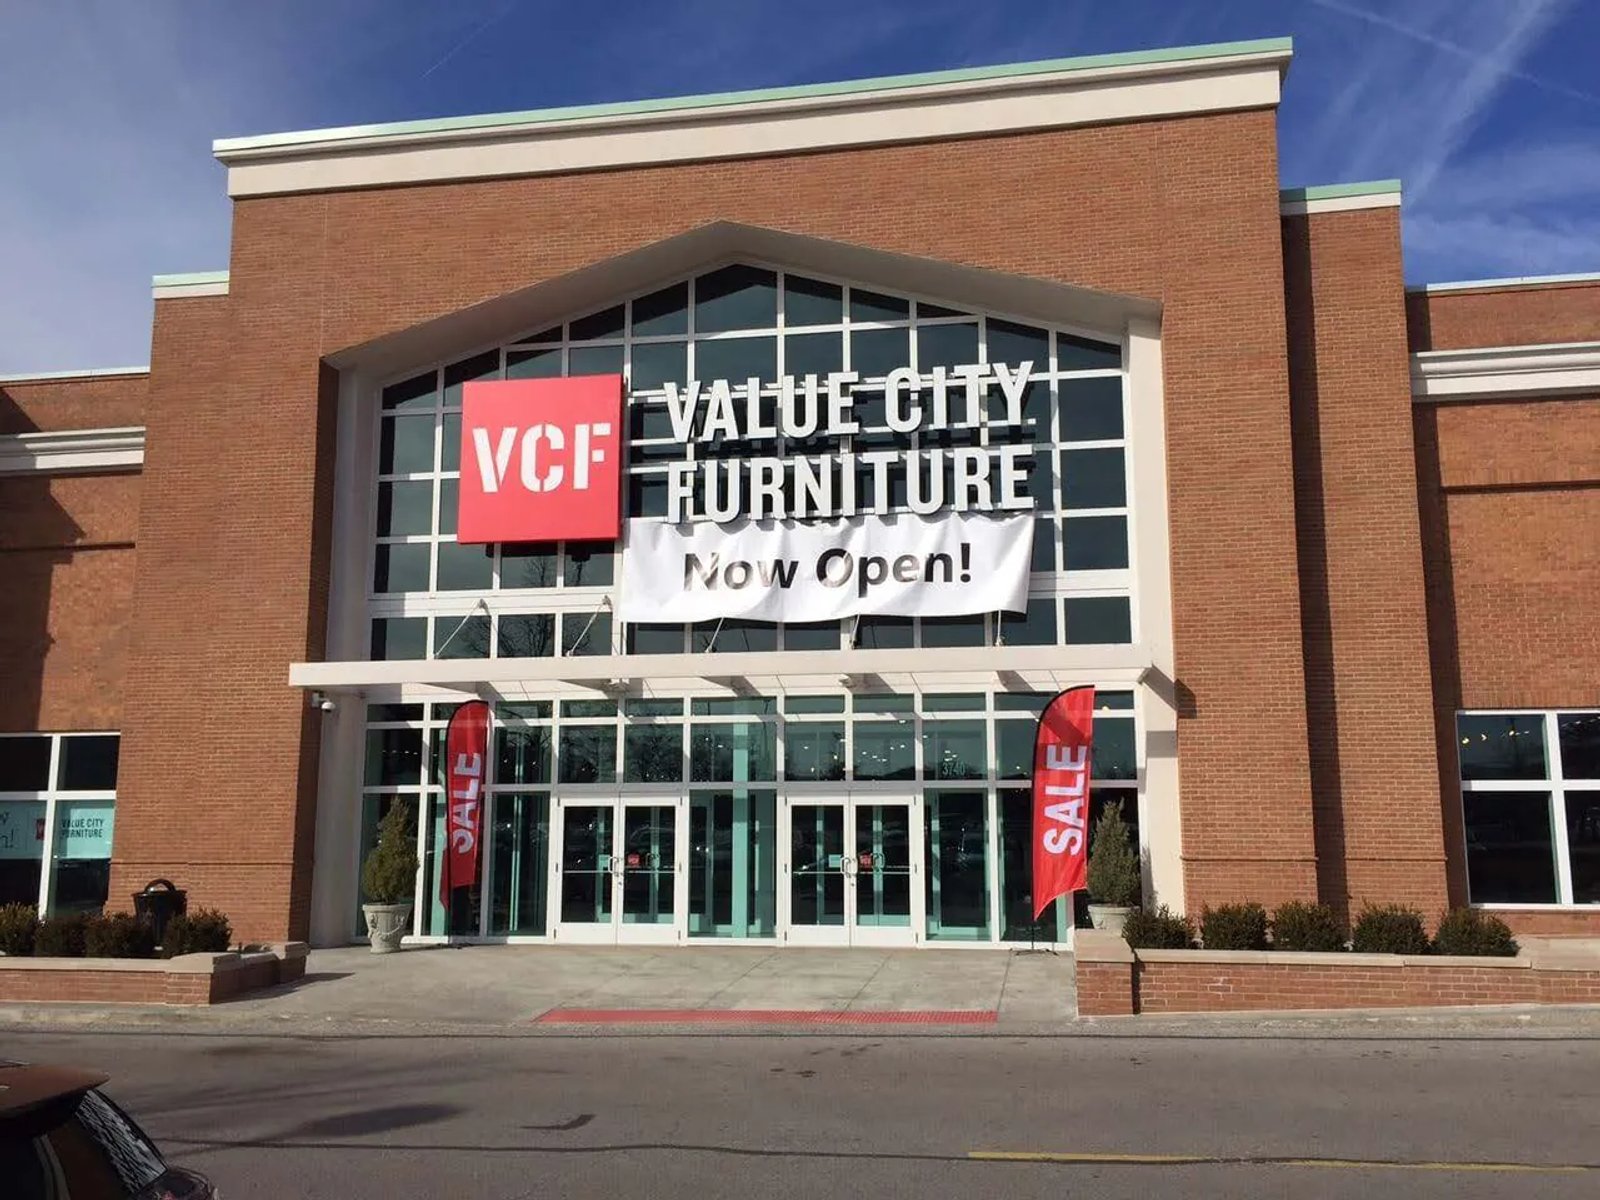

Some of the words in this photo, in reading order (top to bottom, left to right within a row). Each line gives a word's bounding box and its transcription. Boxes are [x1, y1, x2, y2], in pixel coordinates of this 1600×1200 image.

[664, 370, 860, 445] VALUE
[884, 360, 1035, 433] CITY
[472, 422, 612, 494] VCF
[666, 443, 1036, 525] FURNITURE
[684, 550, 799, 593] Now
[816, 542, 973, 598] Open!
[61, 819, 84, 828] VALUE
[86, 818, 104, 828] CITY
[61, 828, 103, 839] FURNITURE
[452, 752, 481, 854] SALE
[1043, 744, 1086, 856] SALE
